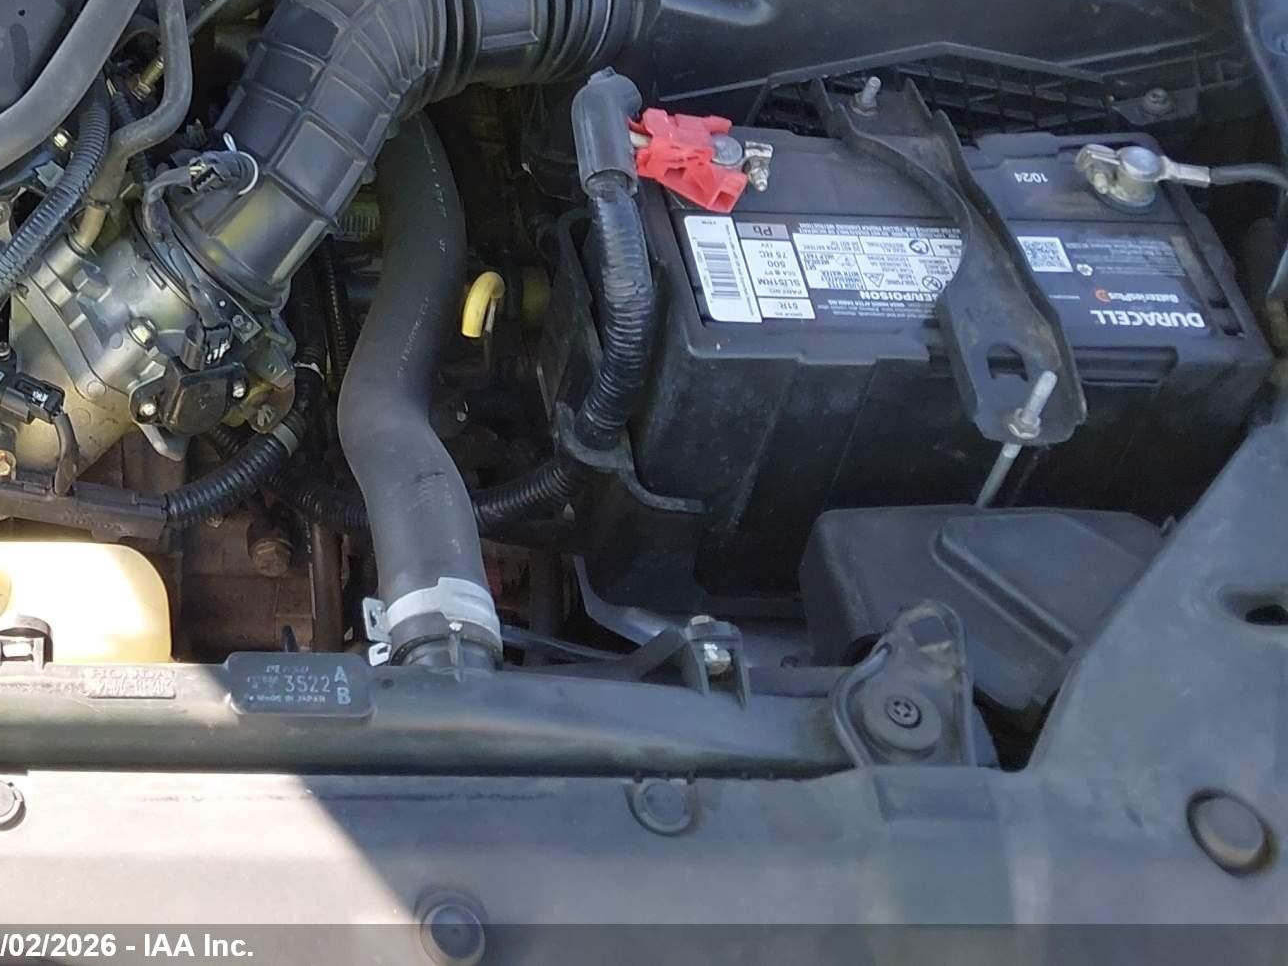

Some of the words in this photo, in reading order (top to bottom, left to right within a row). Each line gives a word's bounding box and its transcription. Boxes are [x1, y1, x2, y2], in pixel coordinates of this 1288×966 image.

[1014, 171, 1049, 183] 10/24
[752, 225, 773, 237] Pb
[759, 250, 773, 258] RC
[767, 260, 786, 268] 500
[779, 301, 799, 310] 51R
[1089, 310, 1205, 328] DURACELL
[284, 675, 331, 692] 3522
[334, 665, 348, 683] A
[337, 687, 351, 705] B
